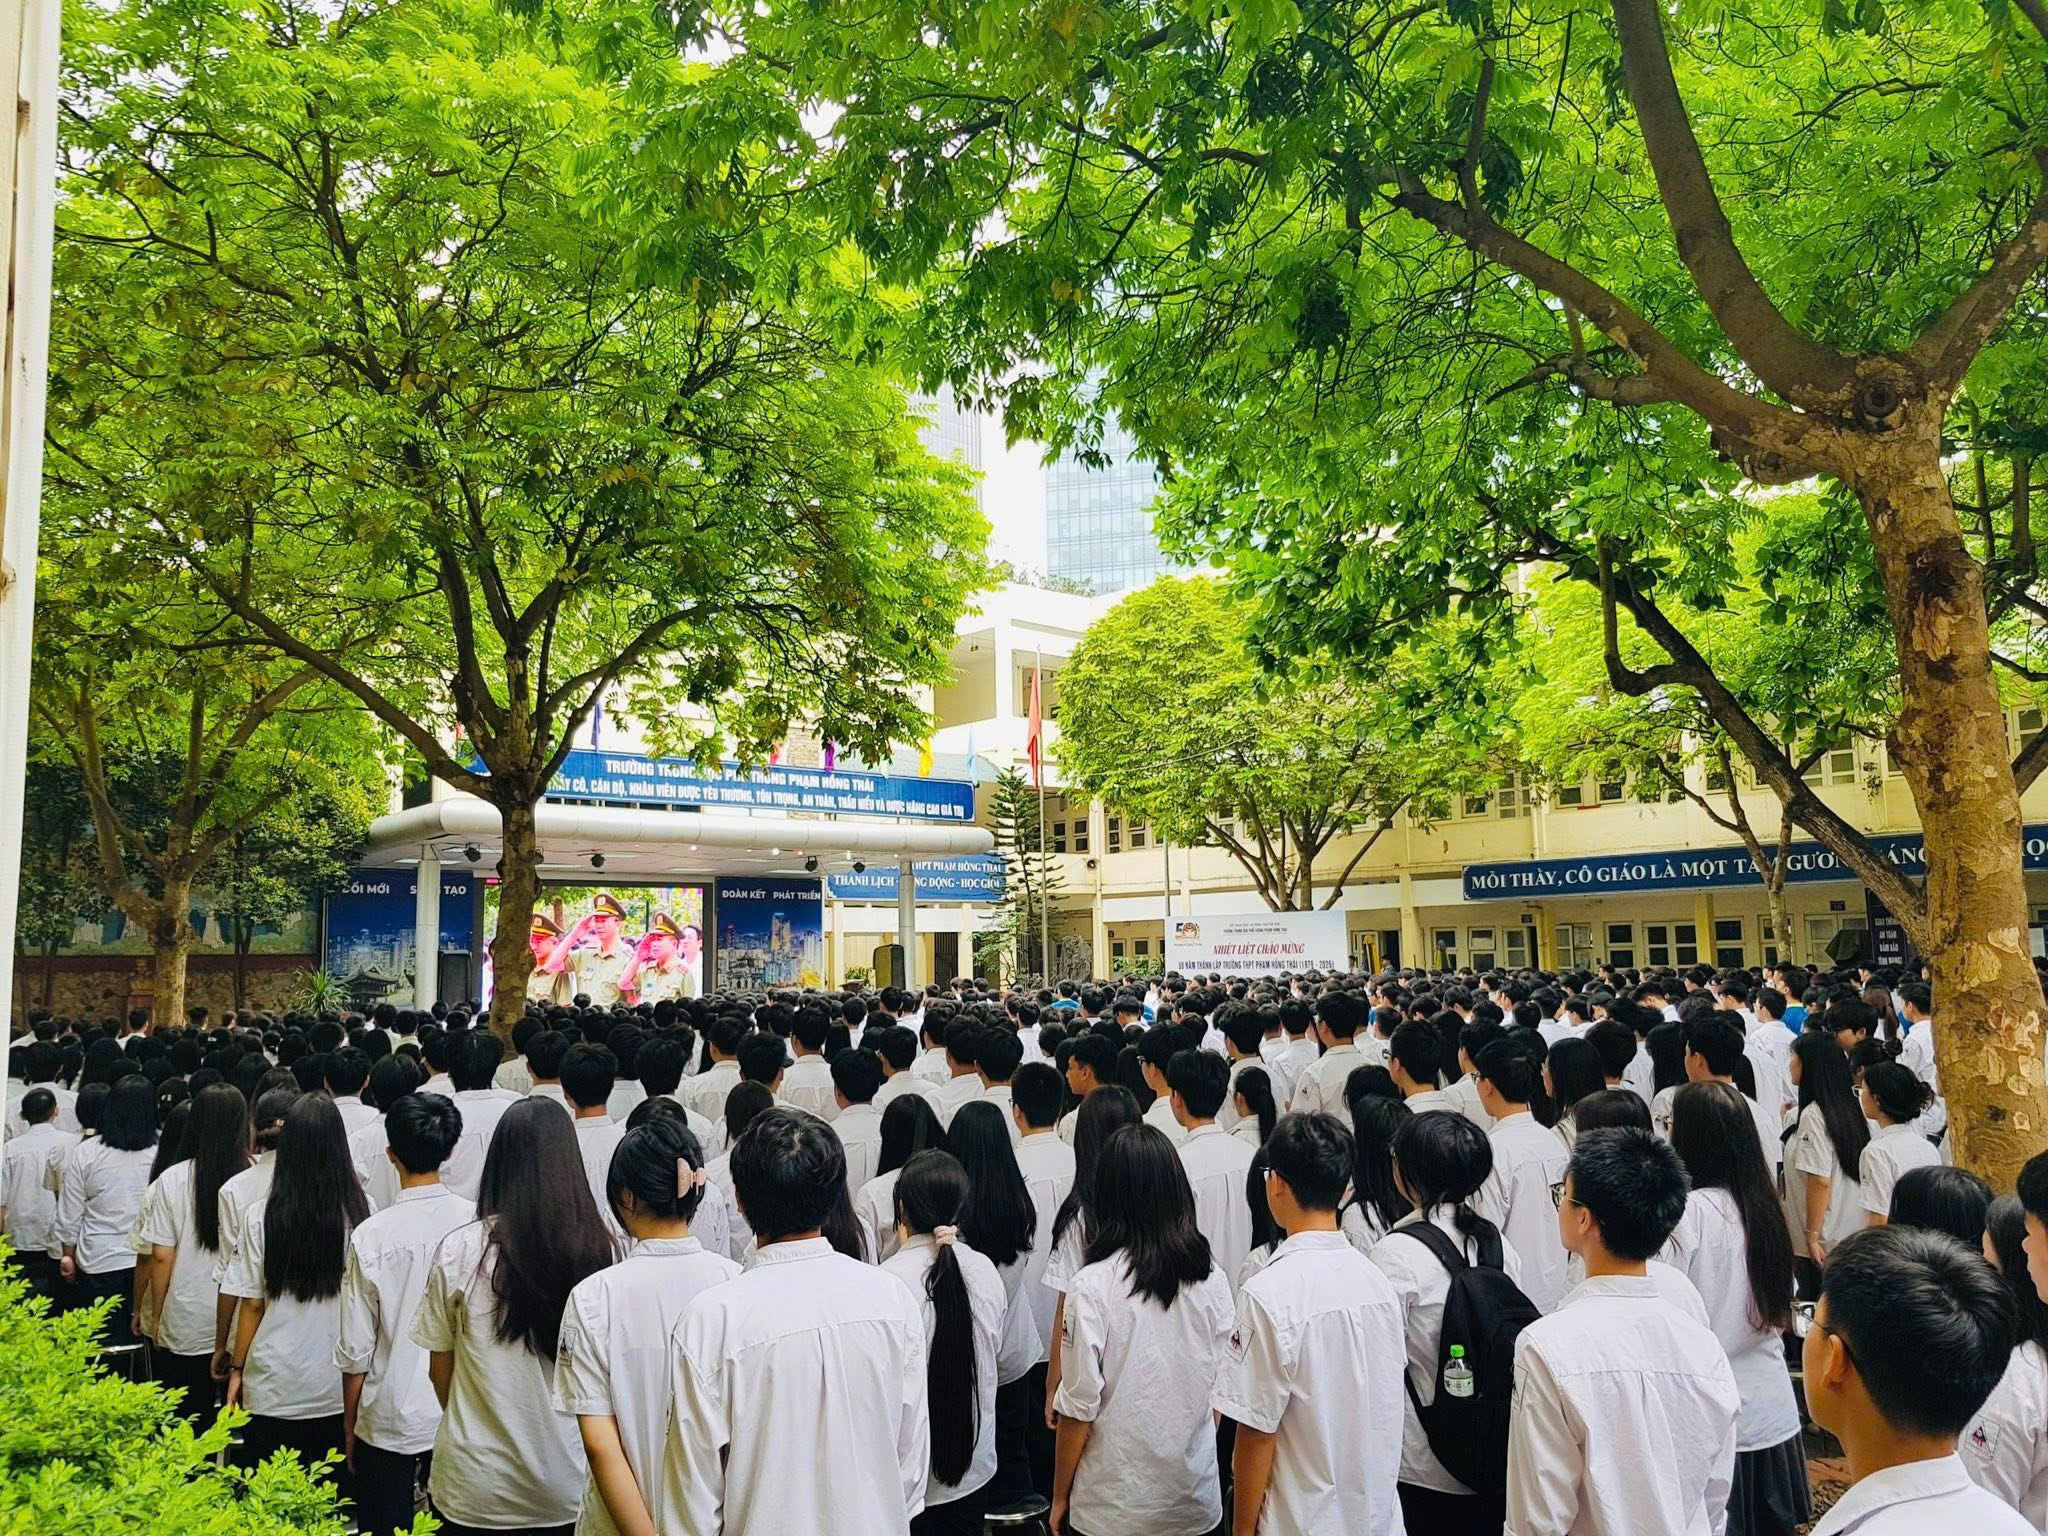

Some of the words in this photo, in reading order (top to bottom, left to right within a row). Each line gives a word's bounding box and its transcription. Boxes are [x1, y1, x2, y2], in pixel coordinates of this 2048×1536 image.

[606, 759, 654, 776] TRƯỜNG
[788, 773, 820, 790] PHẠM
[852, 778, 875, 793] THÁI
[630, 780, 655, 797] NHÂN
[656, 782, 676, 798] VIÊN
[703, 785, 719, 801] YÊU
[756, 788, 772, 804] TÔN
[802, 793, 814, 807] AN
[926, 803, 940, 816] CAO
[933, 860, 957, 873] PHẠM
[1472, 871, 1507, 889] MỖI
[1565, 864, 1592, 884] CÔ
[1596, 862, 1646, 882] GIÁO
[1650, 858, 1677, 879] LÀ
[1681, 858, 1728, 880] MỘT
[367, 879, 390, 894] MỚI
[444, 885, 467, 897] TẠO
[835, 874, 868, 886] THANH
[871, 875, 894, 889] LỊCH
[929, 876, 955, 890] ĐỘNG
[961, 878, 981, 890] HỌC
[750, 888, 766, 899] KẾT
[773, 889, 795, 900] PHÁT
